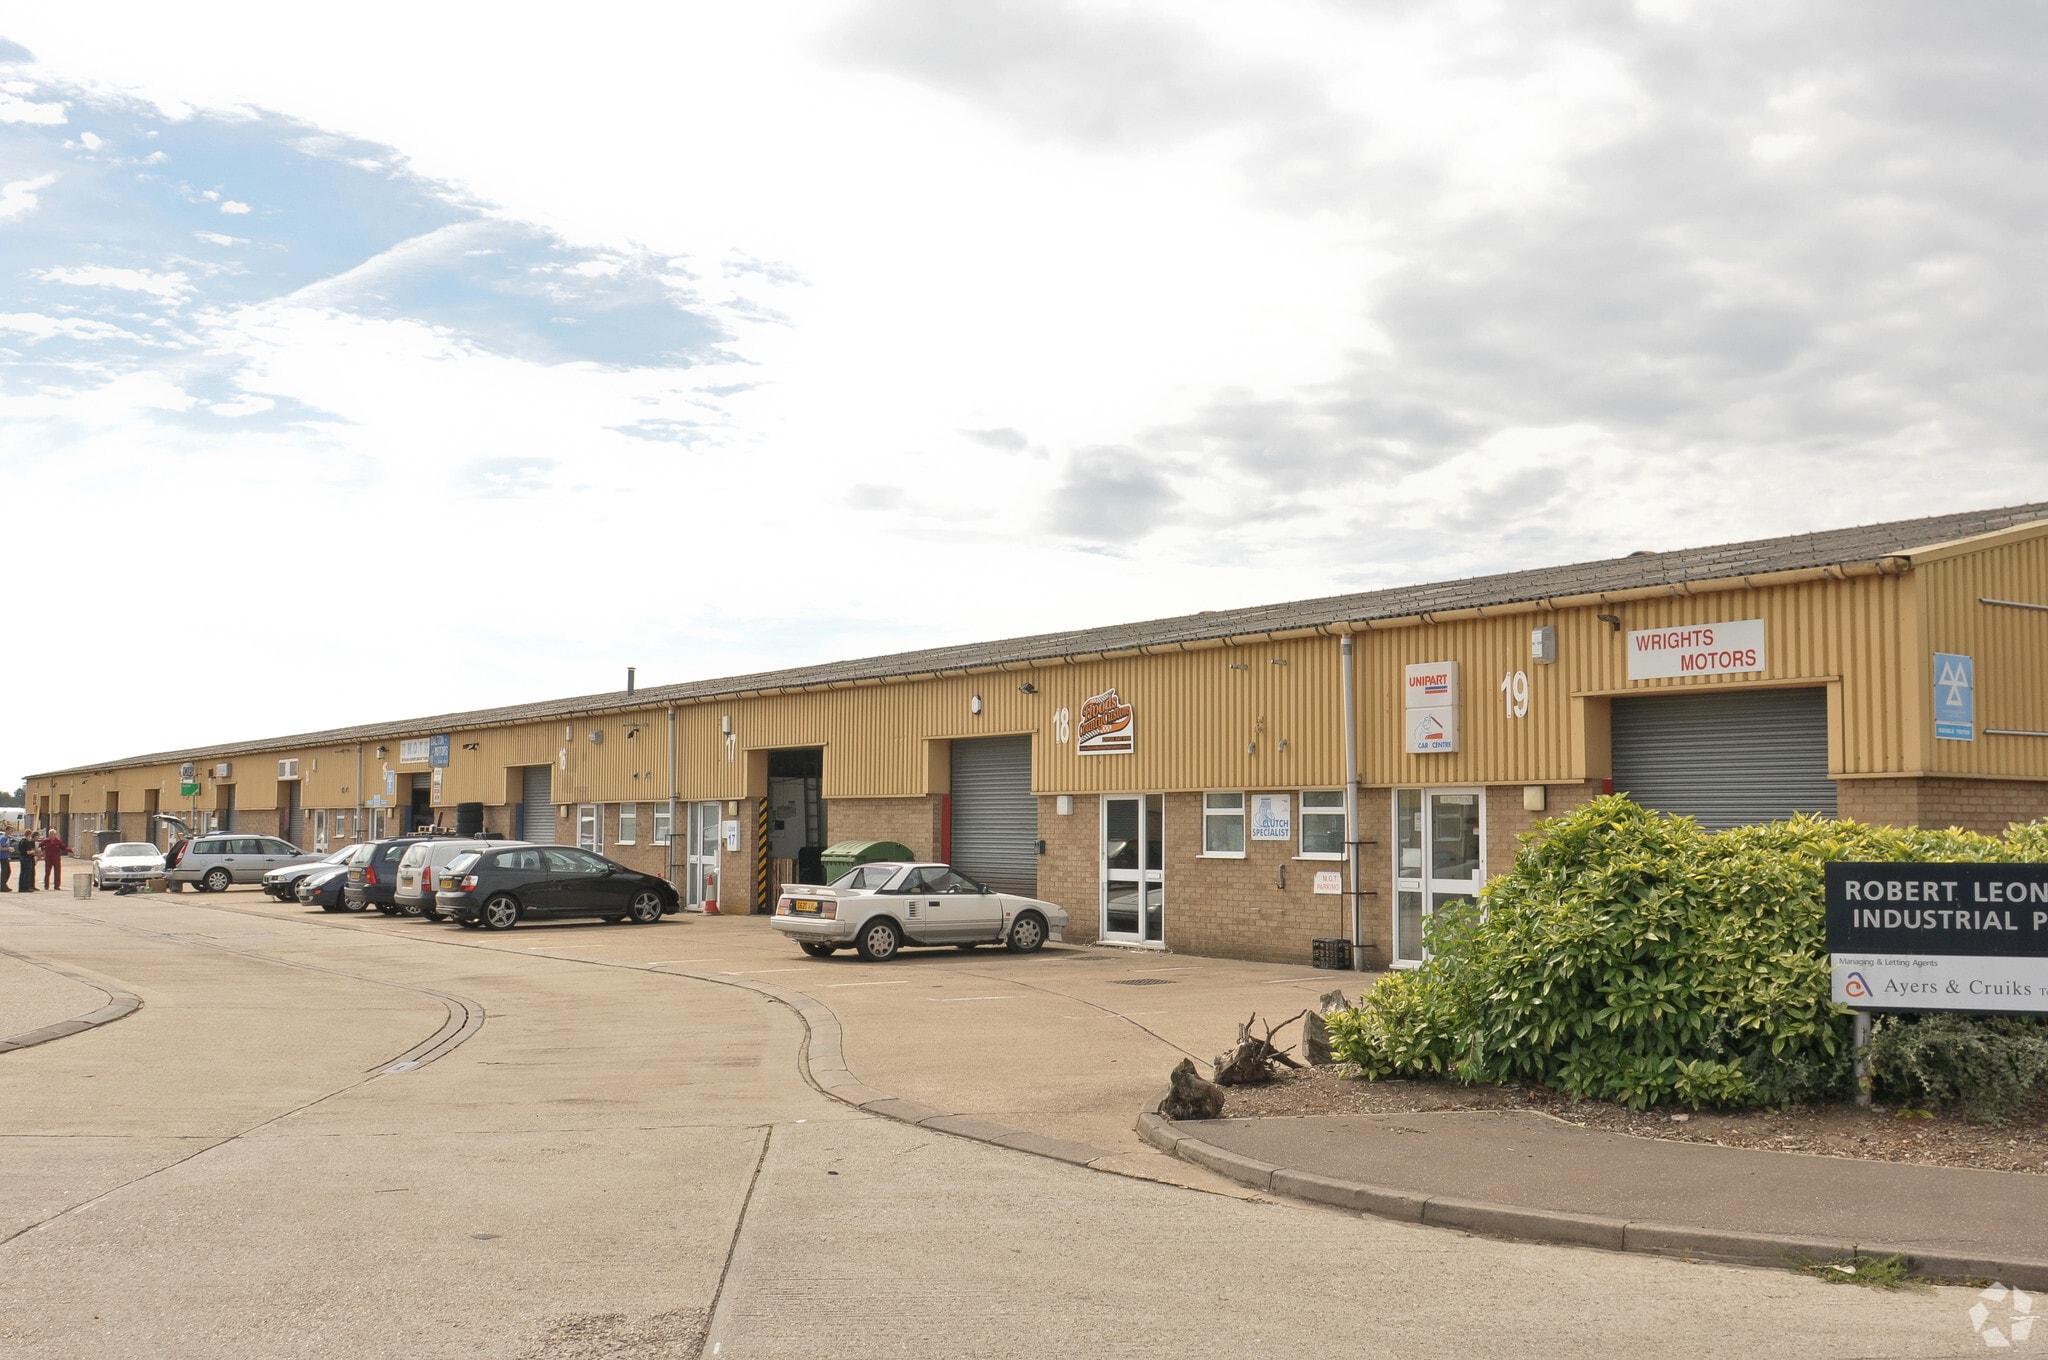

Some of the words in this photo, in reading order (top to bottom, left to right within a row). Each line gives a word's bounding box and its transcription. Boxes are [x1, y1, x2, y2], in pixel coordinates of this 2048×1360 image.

[1636, 629, 1714, 652] WRIGHTS
[1681, 649, 1757, 672] MOTORS
[1409, 674, 1448, 688] UNIPART
[1501, 671, 1529, 719] 19
[1053, 707, 1069, 744] 18
[726, 733, 736, 763] 17
[1418, 742, 1429, 750] CAR
[1432, 741, 1452, 749] CENTRE
[1252, 828, 1289, 837] SPECIALIST
[1262, 819, 1289, 828] CLUTCH
[728, 834, 736, 847] 17
[1316, 883, 1340, 891] PARKING
[1845, 880, 1958, 902] ROBERT
[1974, 881, 2048, 903] LEON
[1853, 909, 2018, 931] INDUSTRIAL
[1839, 957, 1874, 967] Managing
[1876, 958, 1882, 966] &
[1884, 958, 1910, 968] Letting
[1912, 959, 1938, 968] Agents
[1884, 978, 1938, 997] Ayers
[1945, 979, 1960, 994] &
[1969, 979, 2032, 996] Cruiks
